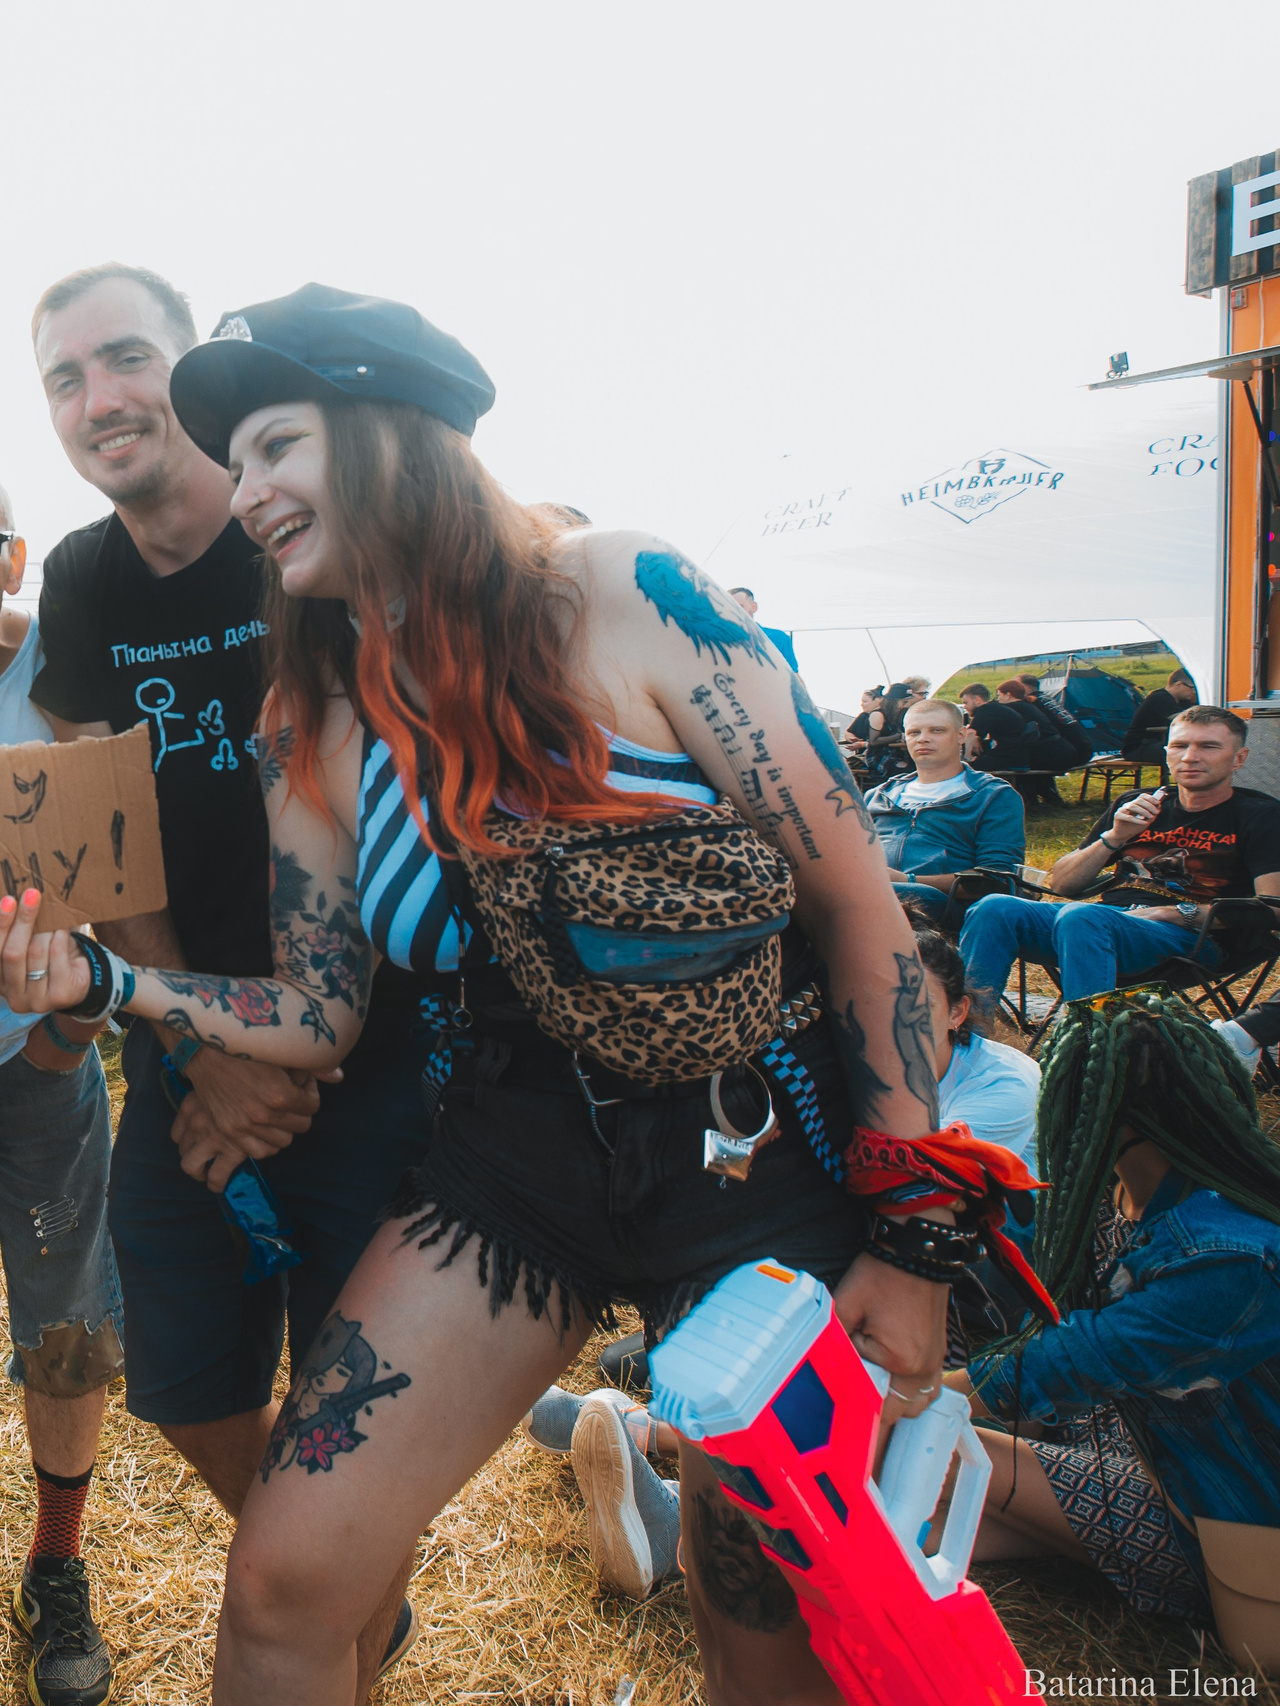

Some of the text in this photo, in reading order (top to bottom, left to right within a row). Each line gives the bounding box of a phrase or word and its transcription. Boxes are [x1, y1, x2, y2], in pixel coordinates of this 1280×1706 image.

[761, 512, 832, 536] BEER
[181, 635, 213, 657] на
[767, 766, 783, 782] is
[777, 785, 822, 860] important
